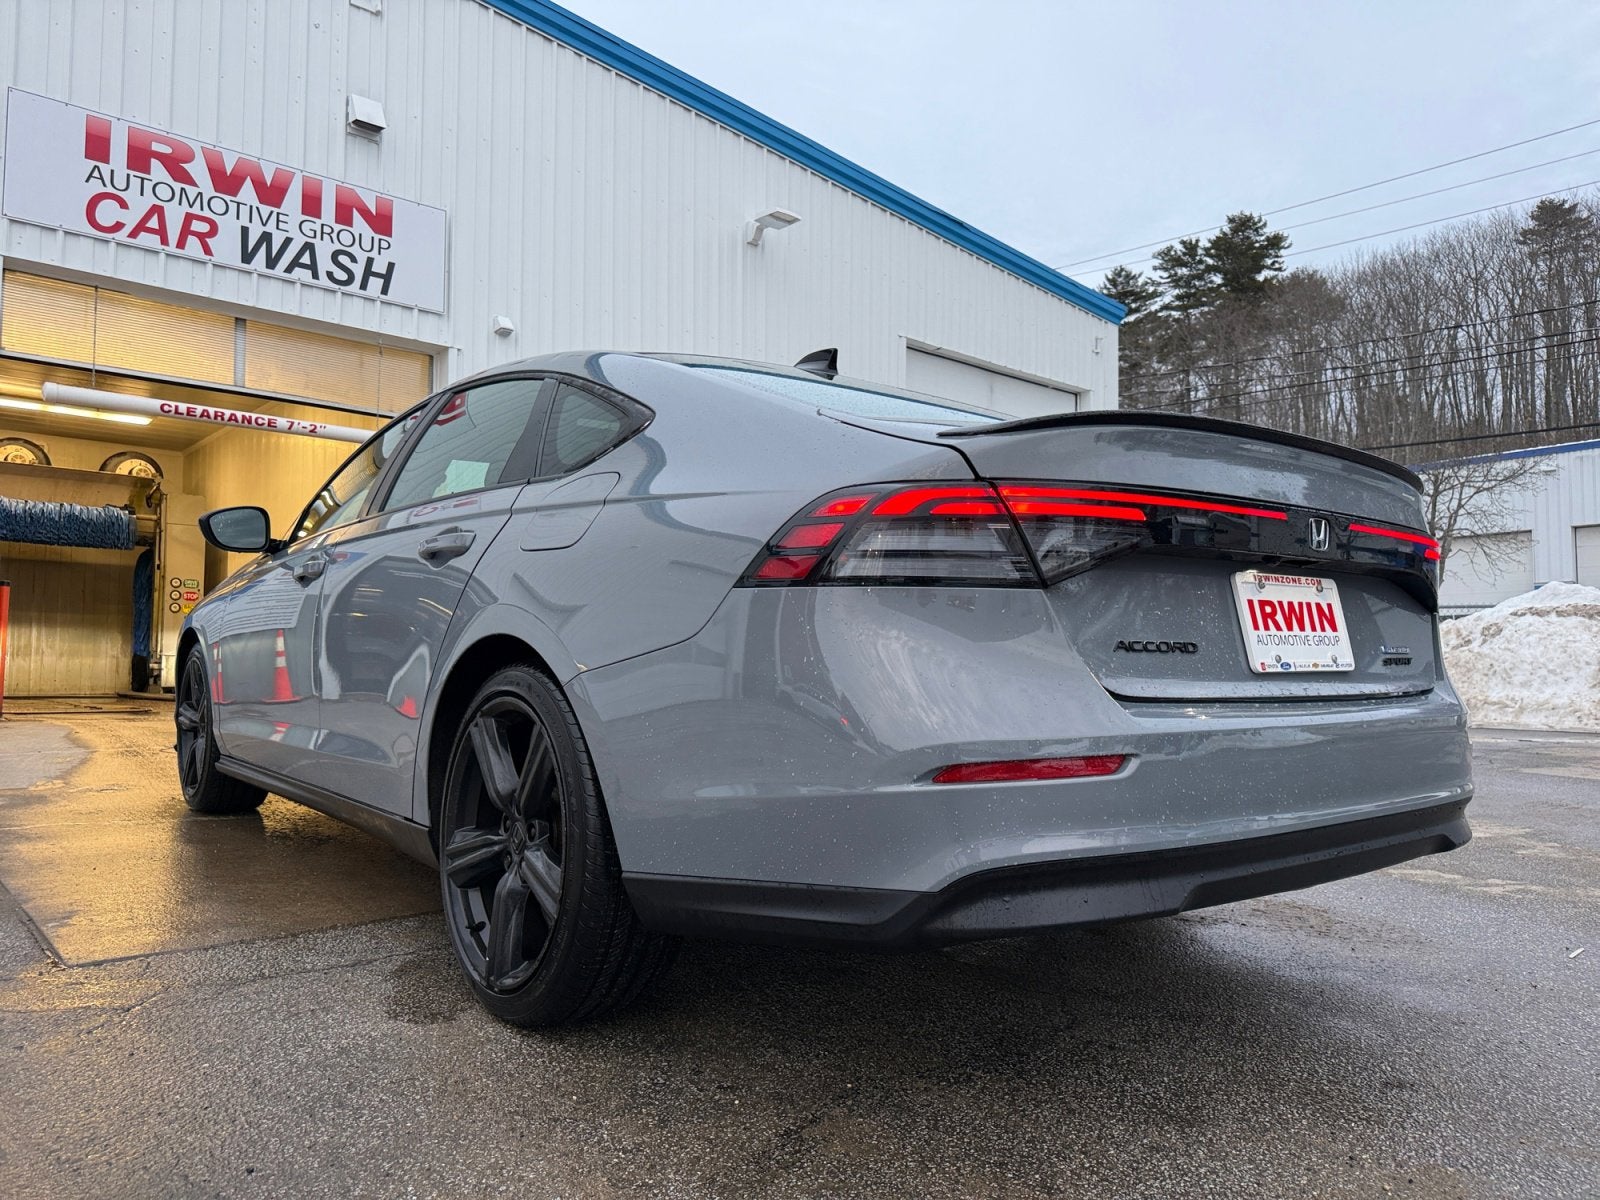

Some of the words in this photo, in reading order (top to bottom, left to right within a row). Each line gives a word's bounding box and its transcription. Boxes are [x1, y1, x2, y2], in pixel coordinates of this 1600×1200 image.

[84, 114, 393, 238] IRWIN
[85, 165, 289, 232] AUTOMOTIVE
[299, 220, 392, 255] GROUP
[85, 191, 219, 257] CAR
[240, 225, 396, 296] WASH
[159, 402, 278, 429] CLEARANCE
[286, 420, 327, 434] 7'-2"
[183, 592, 199, 600] STOP
[1253, 574, 1322, 586] IRWINZONE.COM
[1247, 599, 1338, 632] IRWIN
[1113, 640, 1198, 653] ACCORD
[1257, 634, 1312, 646] AUTOMOTIVE
[1314, 635, 1340, 647] GROUP
